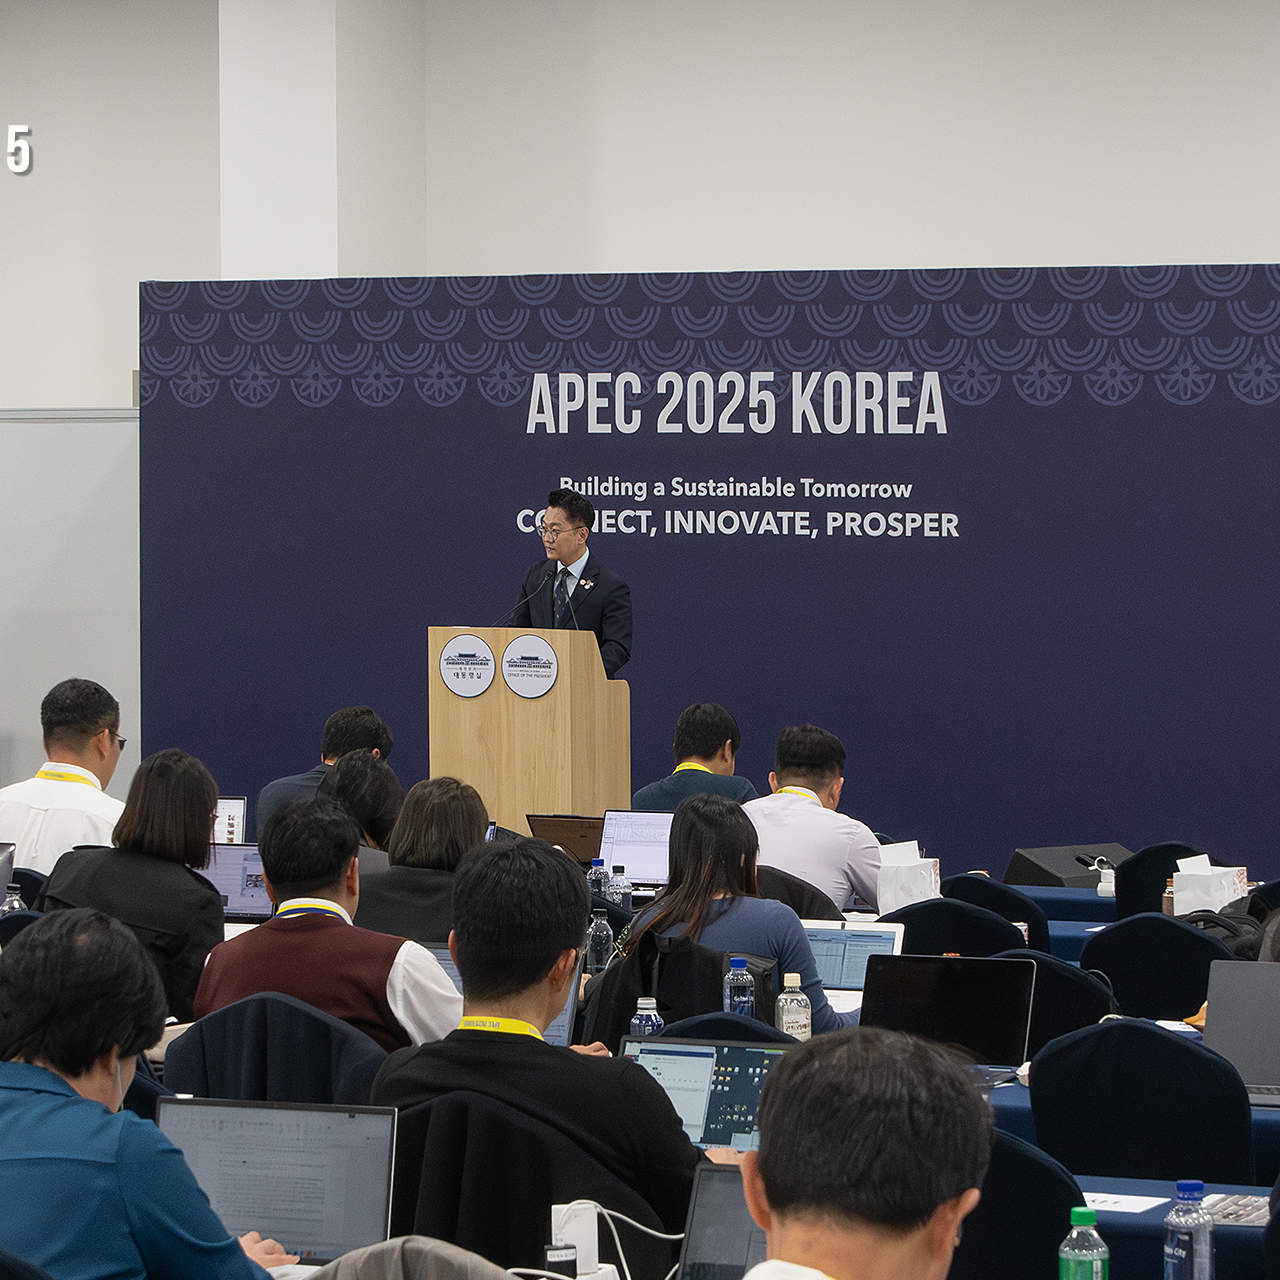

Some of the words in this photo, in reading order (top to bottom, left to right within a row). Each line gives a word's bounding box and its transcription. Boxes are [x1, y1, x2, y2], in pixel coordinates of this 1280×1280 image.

[526, 371, 642, 434] APEC
[656, 371, 776, 434] 2025
[792, 371, 948, 435] KOREA
[560, 475, 647, 502] Building
[653, 481, 666, 497] a
[671, 476, 796, 498] Sustainable
[800, 478, 913, 499] Tomorrow
[516, 508, 658, 538] CECT,
[665, 510, 819, 539] INNOVATE,
[826, 511, 960, 537] PROSPER
